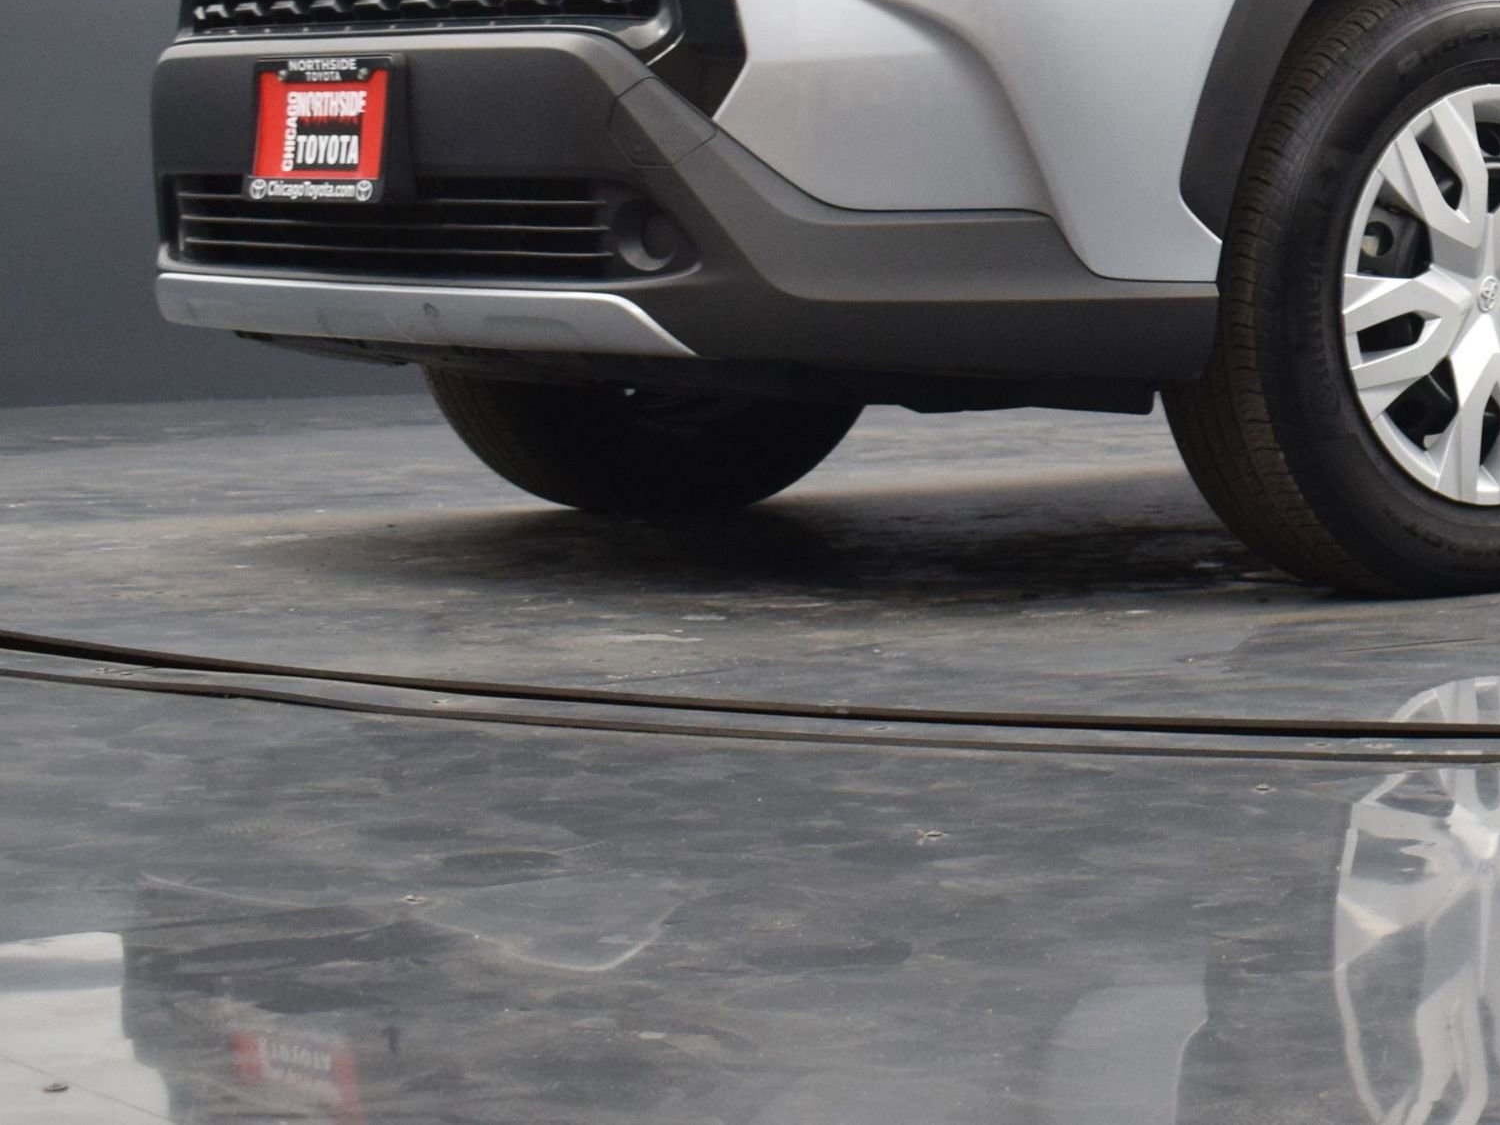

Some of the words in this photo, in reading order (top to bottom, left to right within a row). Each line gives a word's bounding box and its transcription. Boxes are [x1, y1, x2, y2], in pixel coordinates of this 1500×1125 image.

[288, 59, 357, 71] NORTHSIDE
[305, 71, 342, 81] TOYOTA
[297, 91, 367, 117] NORTHSIDE
[281, 92, 298, 171] CHICAGO
[296, 135, 359, 164] TOYOTA
[268, 181, 355, 199] ChicagoToyota.com
